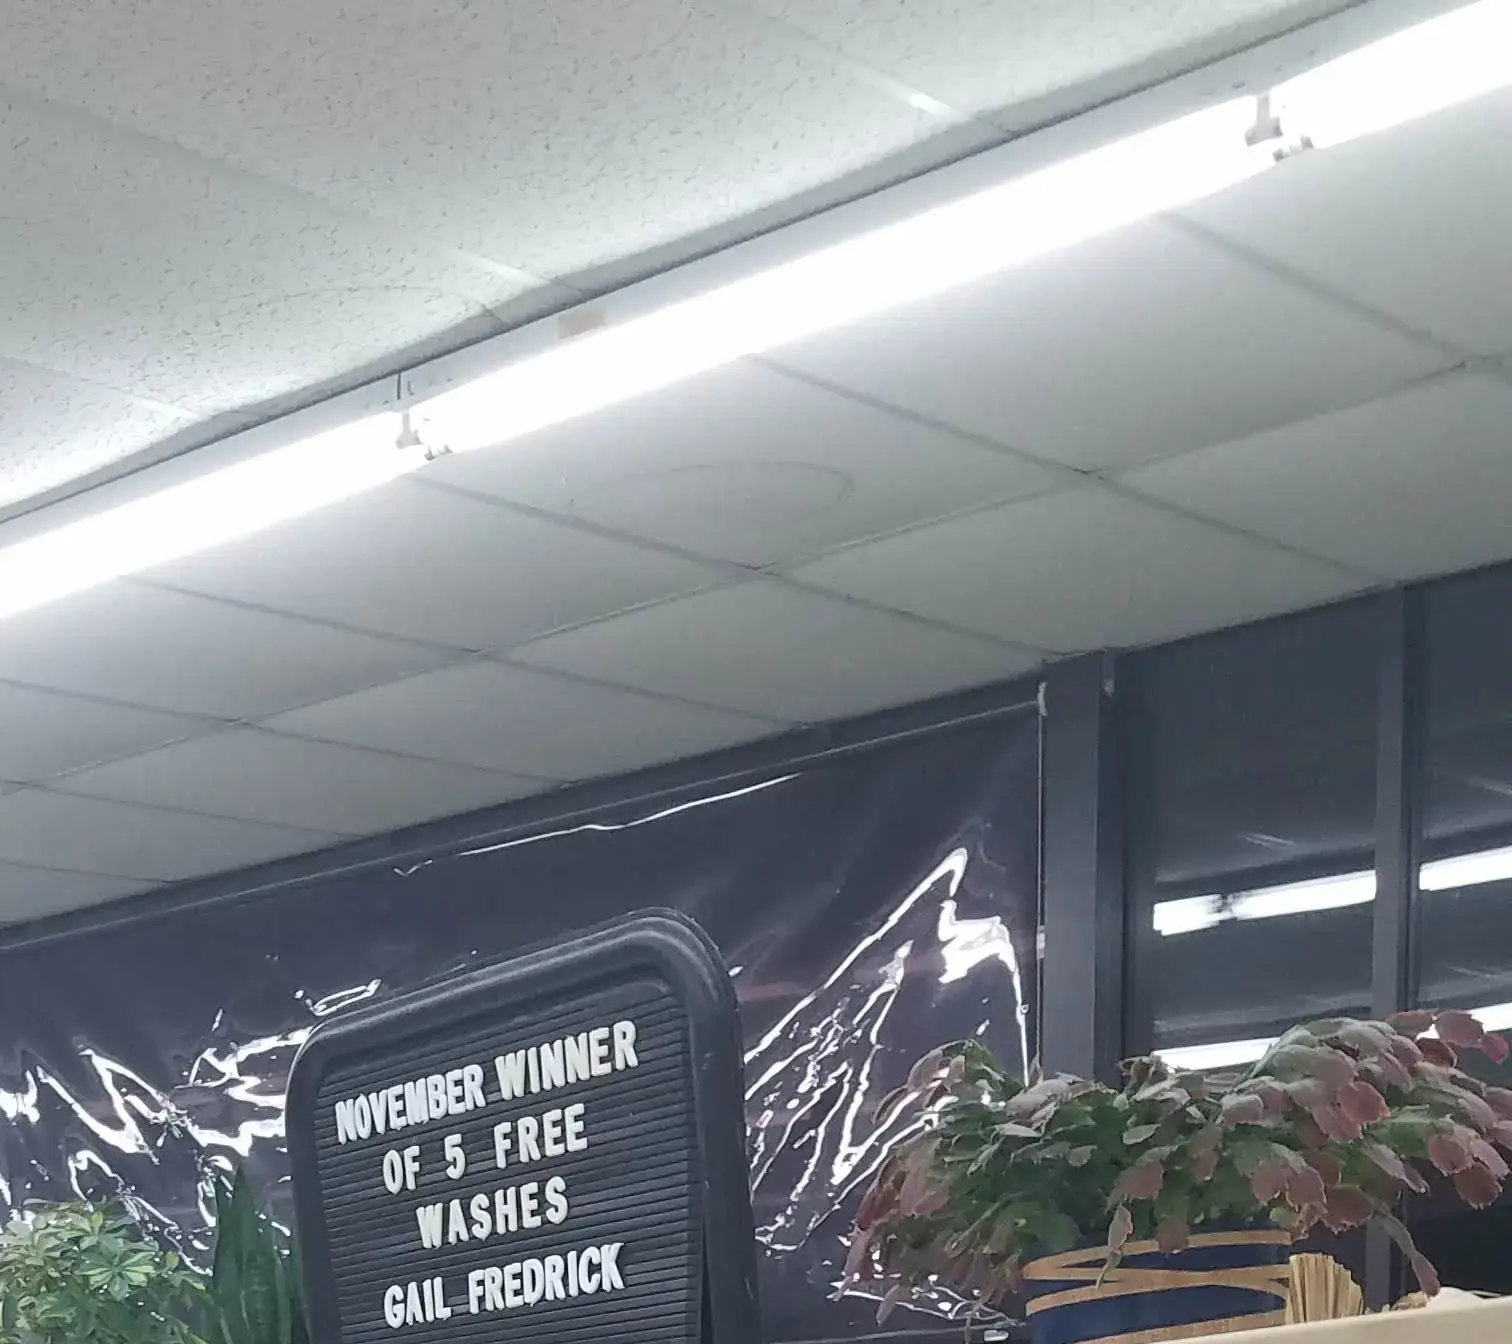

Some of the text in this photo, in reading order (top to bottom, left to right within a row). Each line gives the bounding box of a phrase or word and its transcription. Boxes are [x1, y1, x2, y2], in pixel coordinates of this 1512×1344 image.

[335, 1020, 639, 1145] NOVEMBER WINNER
[382, 1103, 589, 1195] OF 5 FREE
[416, 1176, 570, 1250] WASHES
[384, 1242, 626, 1329] GAIL FREDRICK
